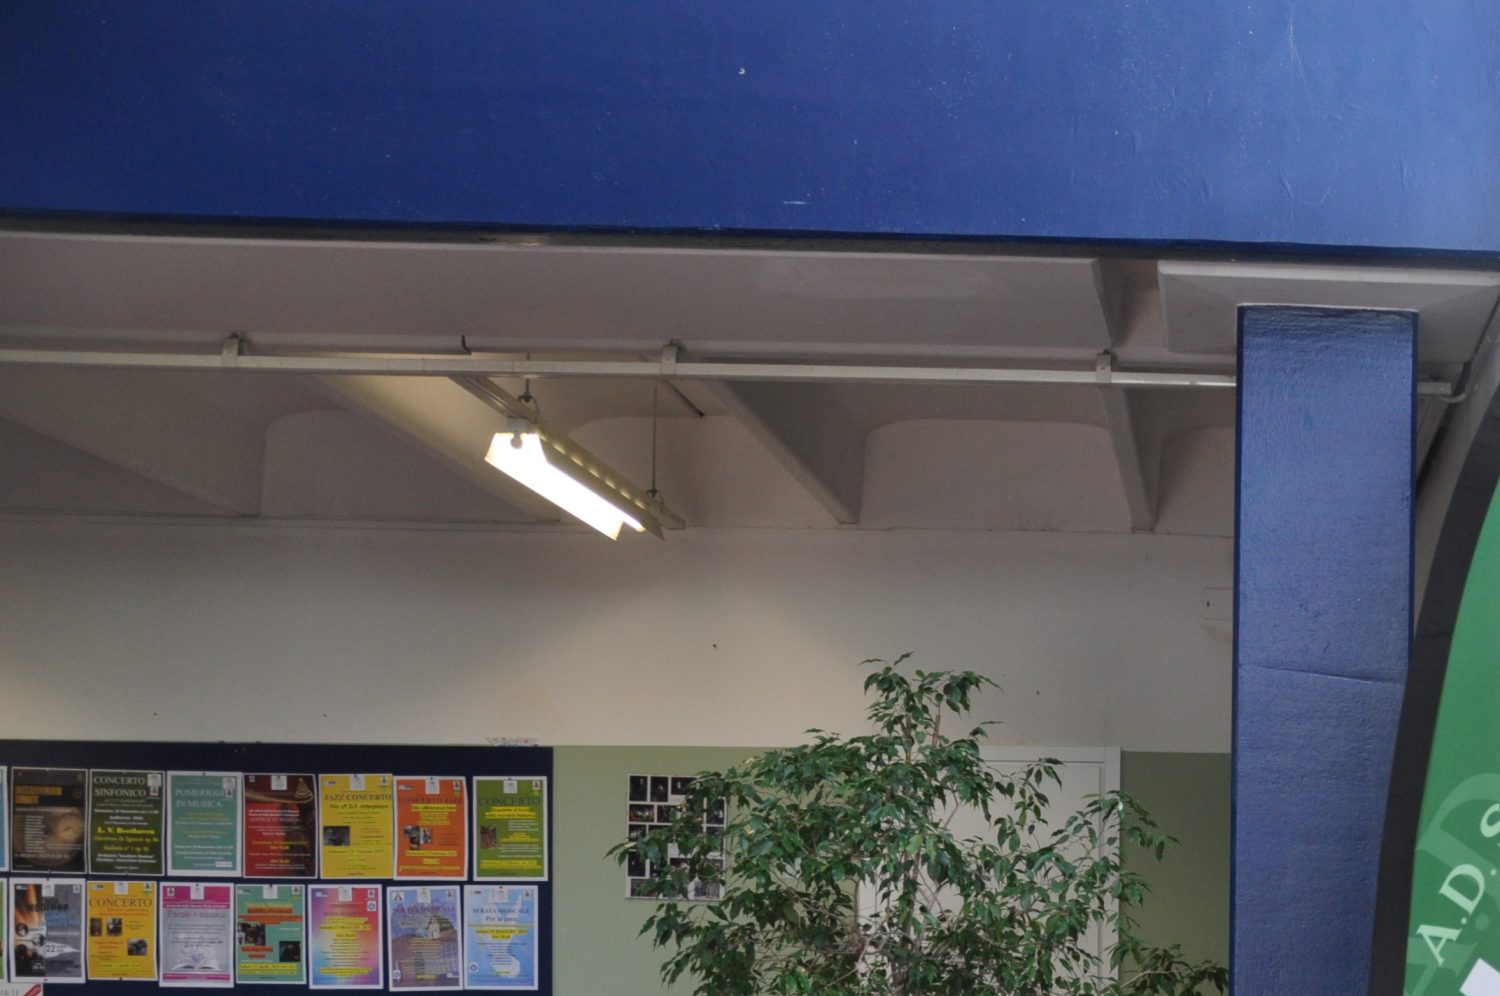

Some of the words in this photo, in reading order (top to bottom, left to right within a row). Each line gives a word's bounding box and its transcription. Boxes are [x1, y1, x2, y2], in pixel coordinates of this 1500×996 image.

[93, 776, 146, 785] CONCERTO
[94, 788, 147, 797] SINFONICO
[479, 796, 541, 806] CONCERTO
[89, 898, 153, 908] CONCERTO
[1416, 863, 1498, 965] A.D.
